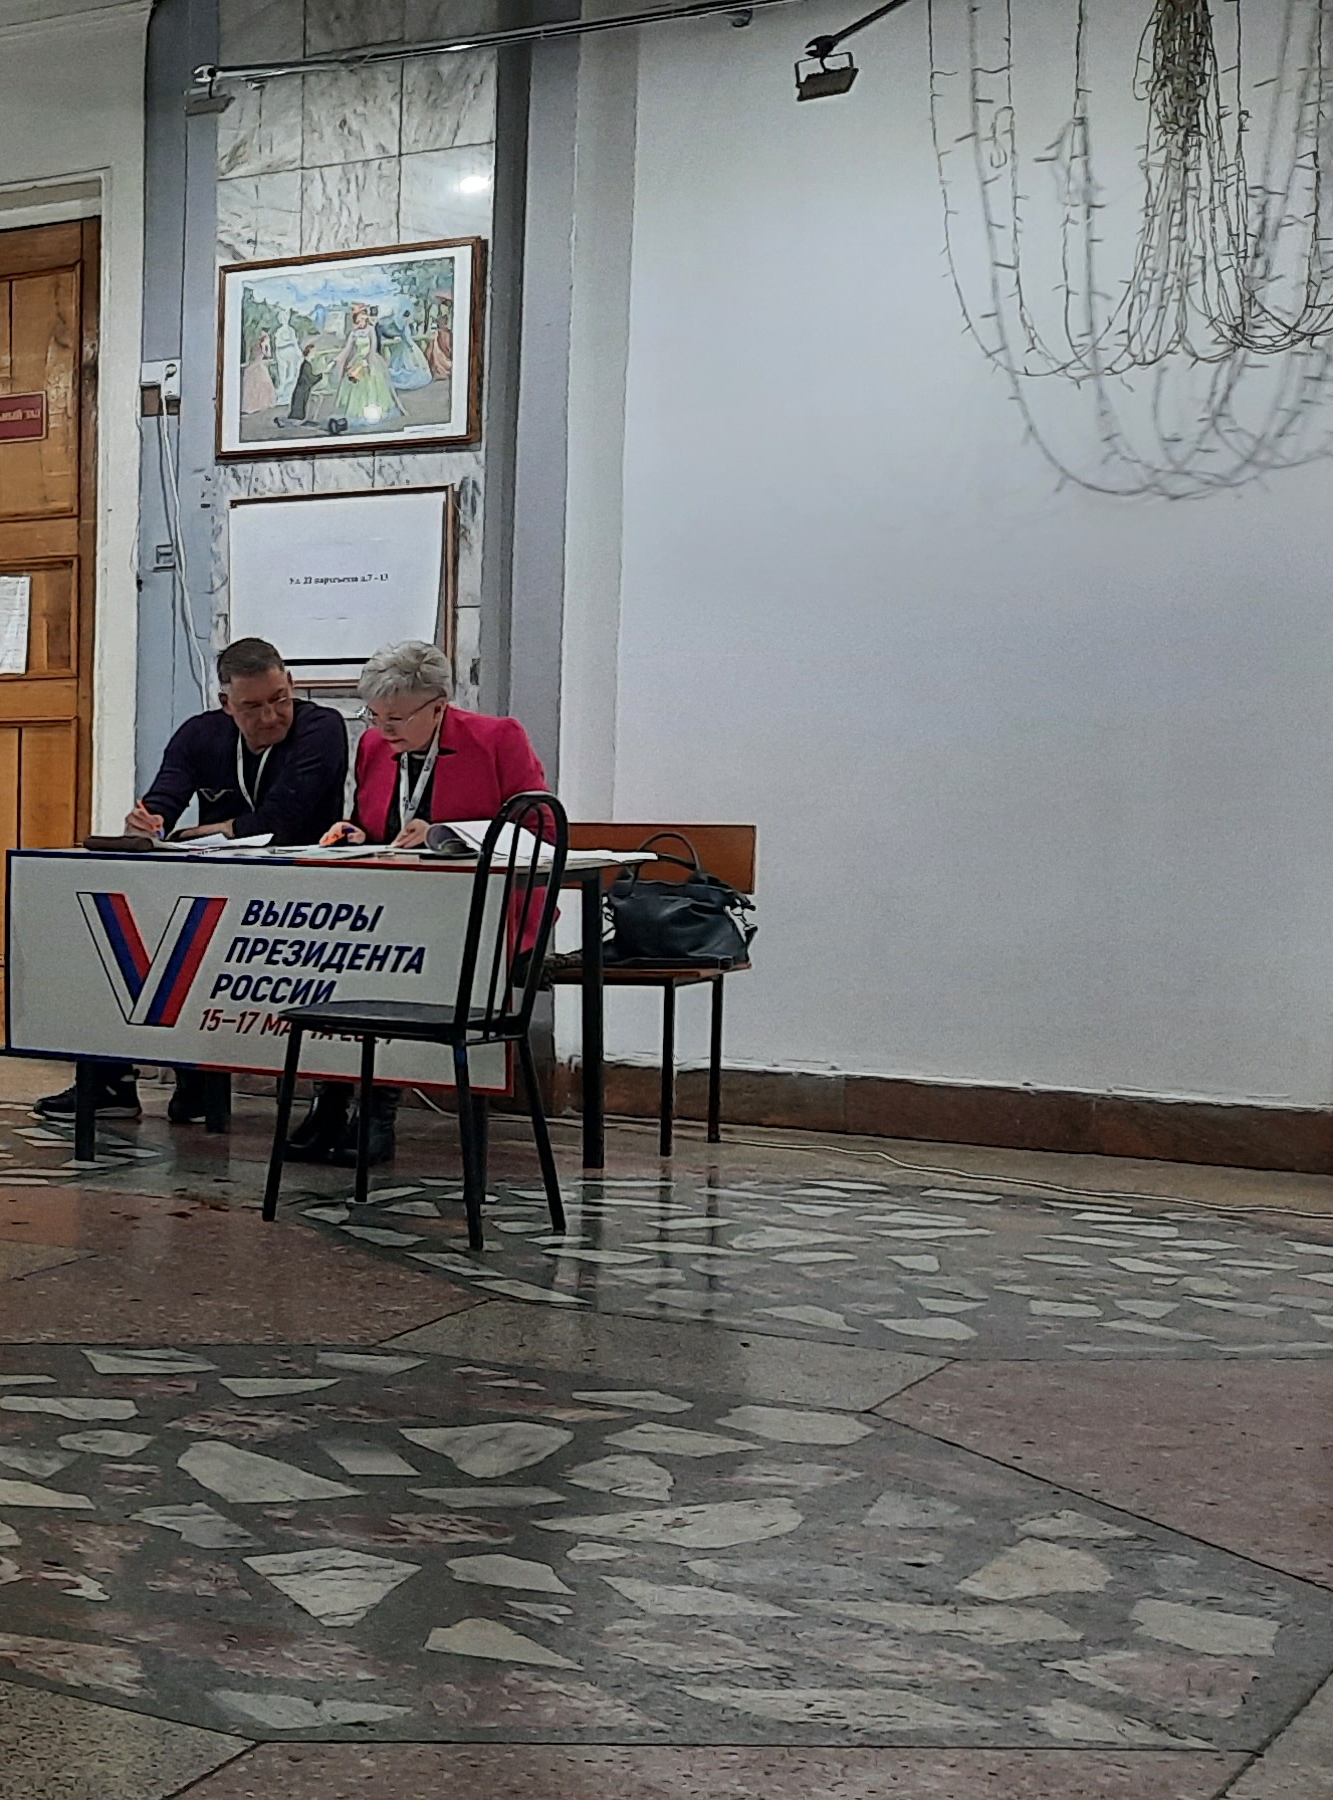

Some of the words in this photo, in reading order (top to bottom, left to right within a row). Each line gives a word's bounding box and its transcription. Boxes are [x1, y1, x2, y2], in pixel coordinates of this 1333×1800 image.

[240, 899, 385, 933] ВЫБОРЫ
[224, 936, 427, 974] ПРЕЗИДЕНТА
[209, 973, 337, 1006] РОССИИ
